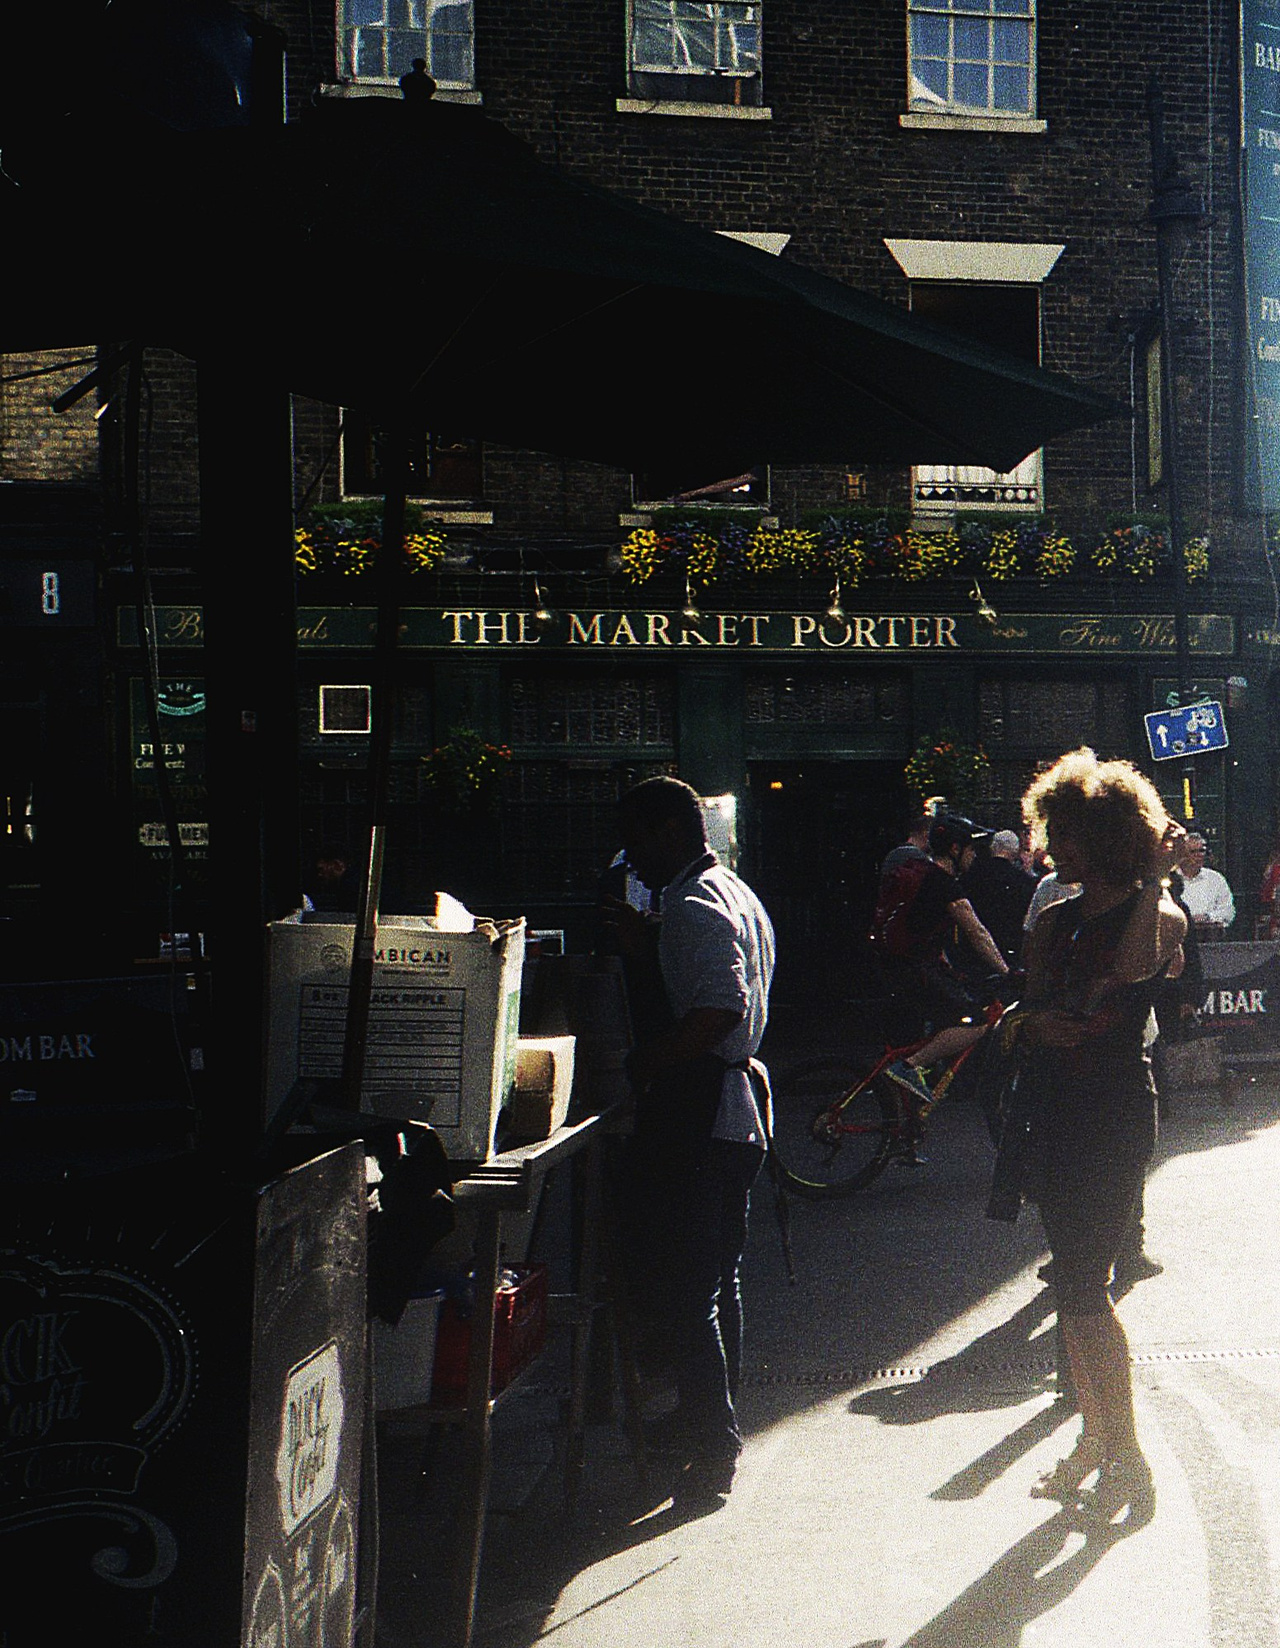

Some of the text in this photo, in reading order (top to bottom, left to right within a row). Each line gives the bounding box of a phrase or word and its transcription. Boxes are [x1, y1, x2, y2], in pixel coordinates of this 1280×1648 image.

[442, 611, 542, 644] THE
[792, 615, 961, 648] PORTER
[1059, 619, 1199, 647] Fine Wins
[140, 743, 174, 755] FIE
[375, 948, 451, 964] MBICAN
[371, 994, 399, 1005] ACK
[1220, 989, 1267, 1015] BAR
[39, 1033, 95, 1060] BAR
[0, 1373, 92, 1441] onfit
